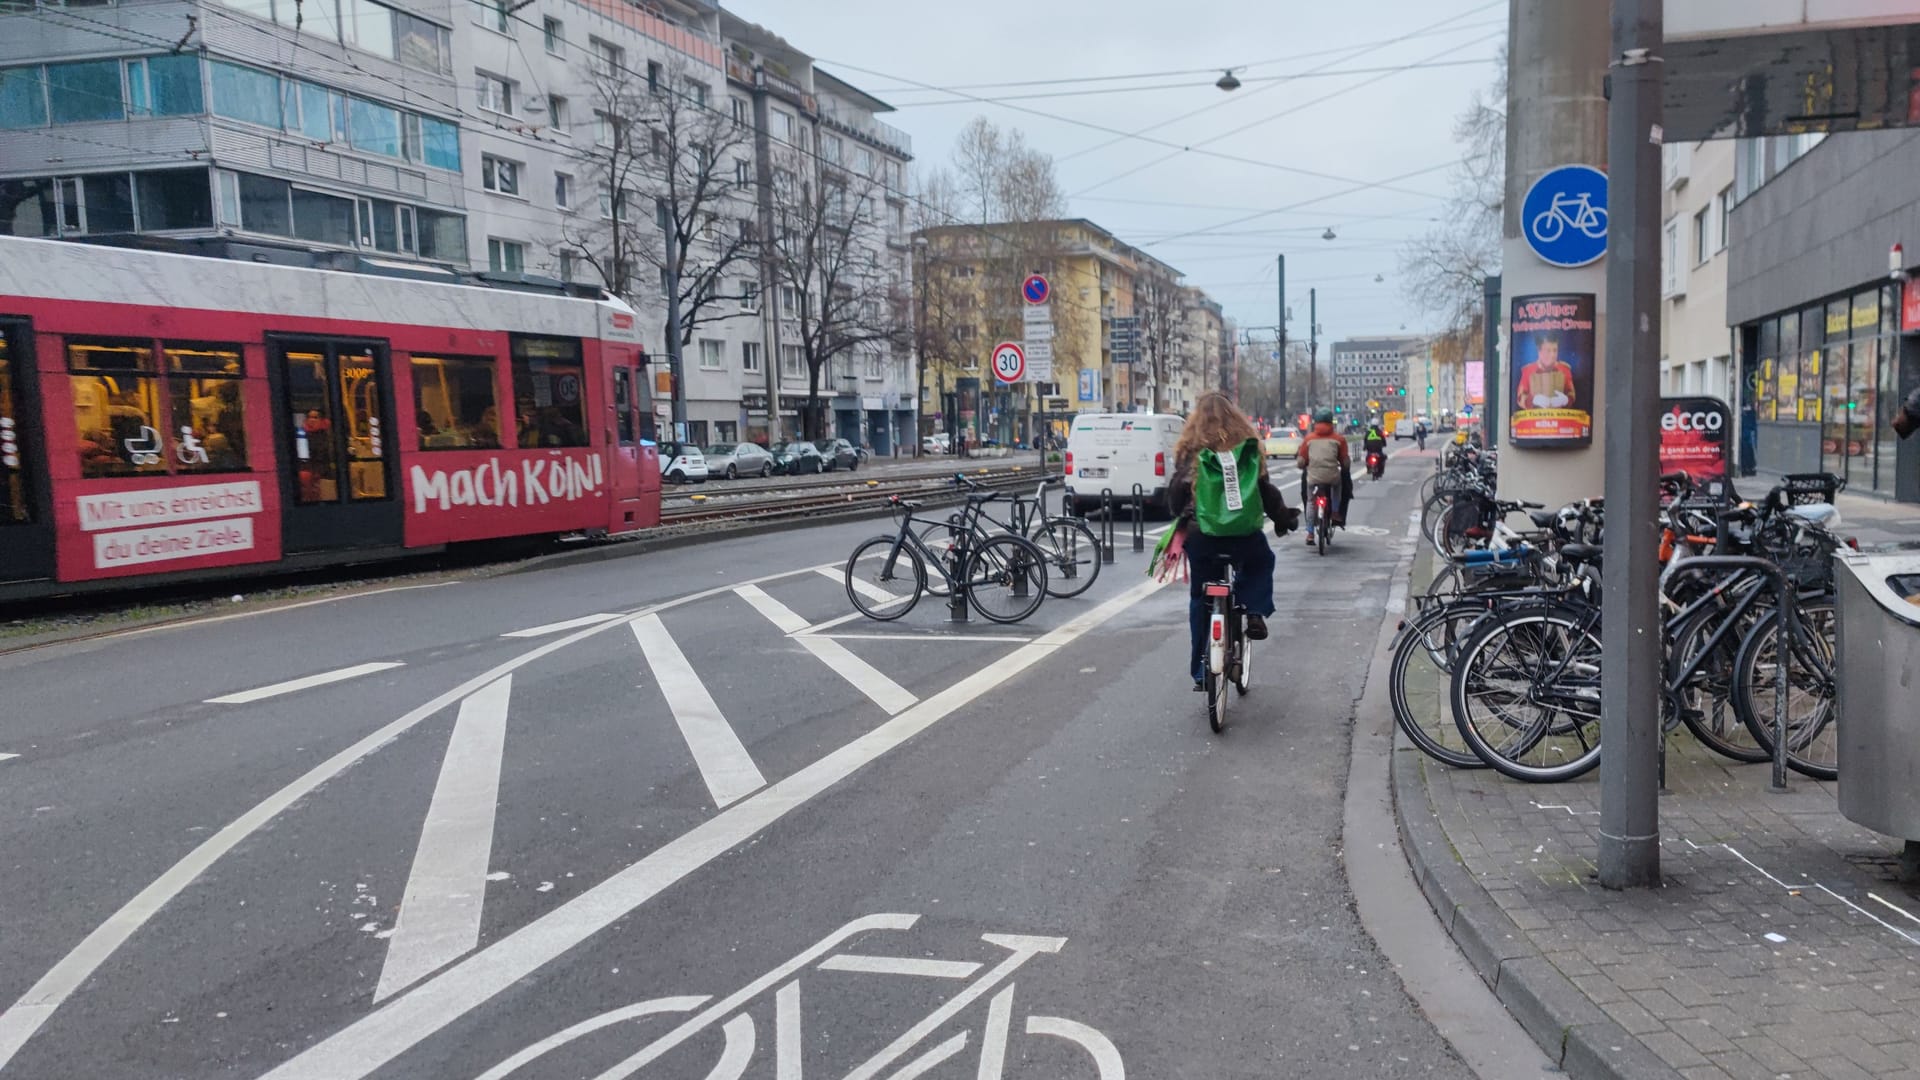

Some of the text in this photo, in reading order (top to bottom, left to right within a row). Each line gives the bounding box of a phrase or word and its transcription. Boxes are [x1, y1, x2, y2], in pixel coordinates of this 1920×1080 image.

[1000, 354, 1018, 371] 30
[1661, 411, 1722, 431] ecco
[87, 488, 255, 522] Mit uns erreichst
[104, 526, 247, 560] du deine Ziele.
